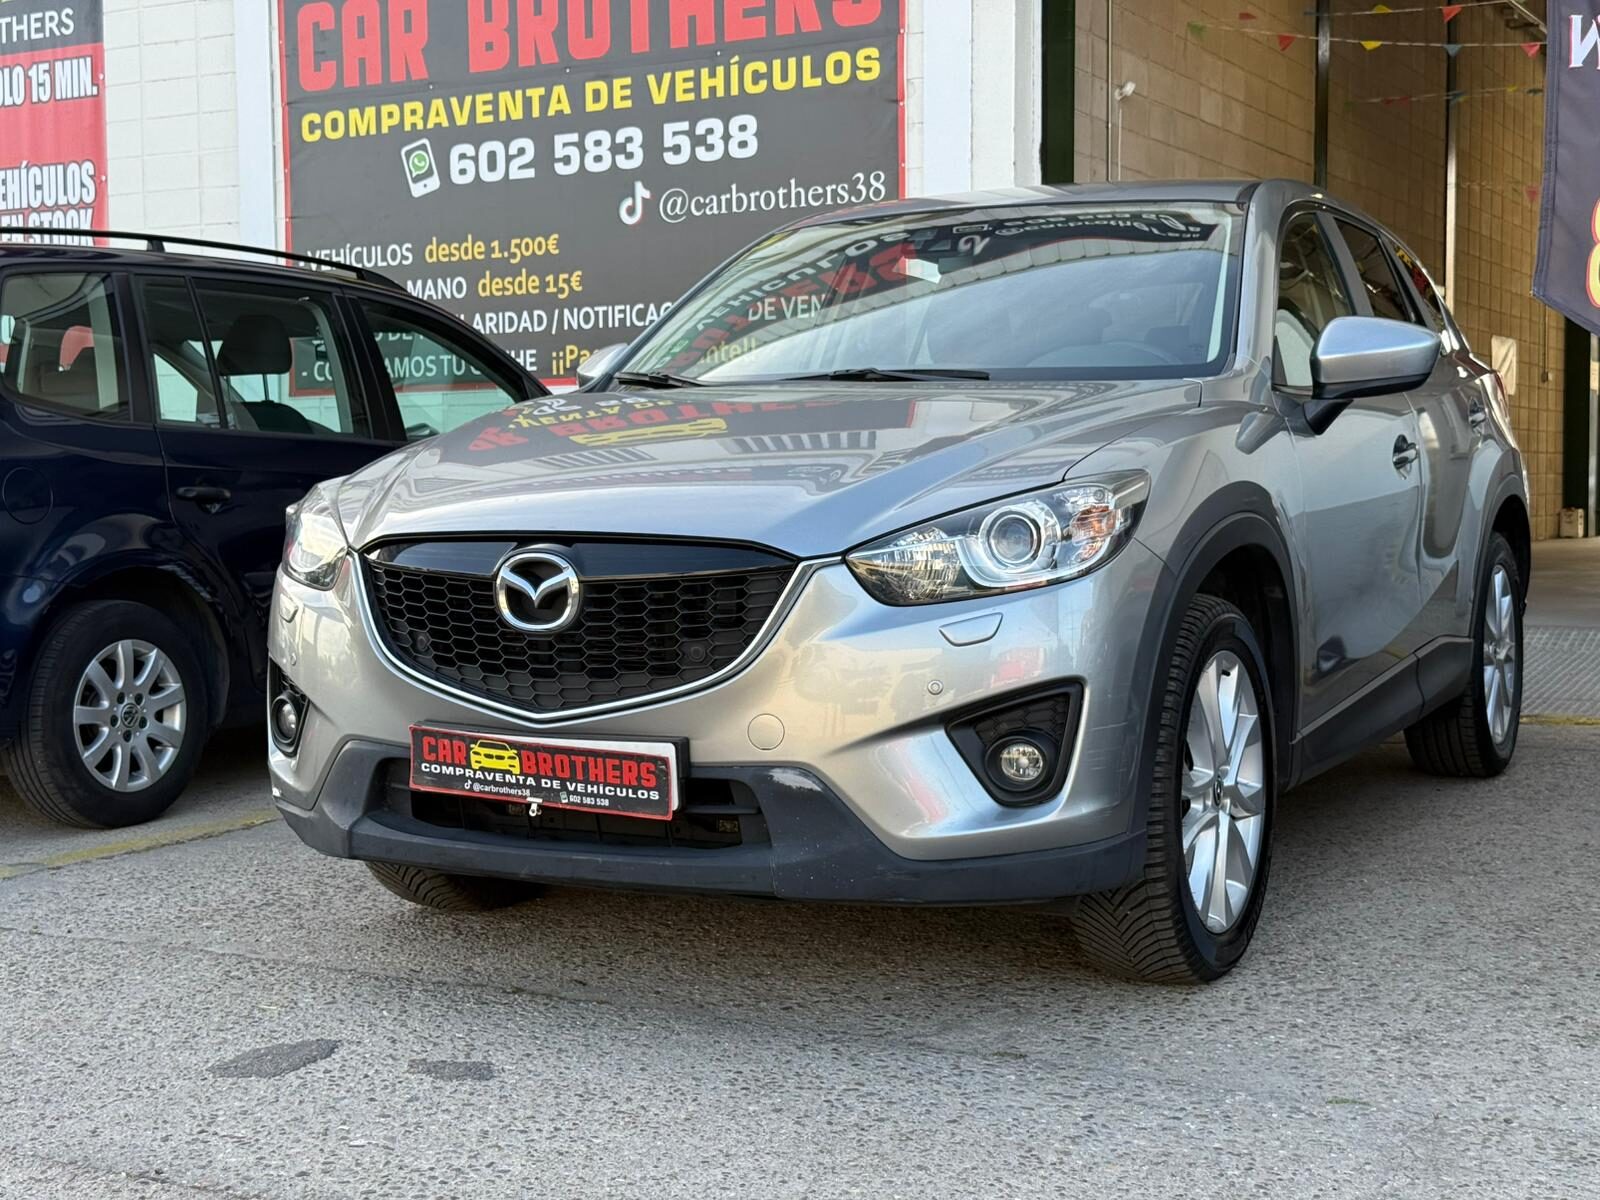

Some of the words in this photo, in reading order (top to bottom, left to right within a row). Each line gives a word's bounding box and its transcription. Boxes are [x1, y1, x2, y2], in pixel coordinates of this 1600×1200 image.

[0, 8, 75, 44] THERS
[297, 0, 429, 92] CAR
[0, 65, 26, 107] LO
[28, 61, 52, 104] 15
[54, 55, 99, 102] MIN.
[301, 84, 572, 143] COMPRAVENTA
[585, 77, 632, 112] DE
[647, 47, 881, 105] VEHÍCULOS
[449, 137, 535, 185] 602
[553, 126, 644, 175] 583
[662, 114, 759, 165] 538
[659, 170, 886, 224] @carbrothers38
[307, 243, 413, 272] VEHÍCULOS
[424, 234, 486, 263] desde
[490, 233, 560, 264] 1.500€
[406, 276, 467, 300] MANO
[477, 268, 540, 298] desde
[545, 270, 583, 299] 15€
[440, 354, 466, 377] TU
[421, 763, 537, 786] COMPRAVENTA
[541, 778, 561, 789] DE
[566, 781, 660, 800] VEHÍCULOS
[422, 736, 467, 765] CAR
[521, 750, 657, 788] BROTHERS
[569, 794, 581, 803] 602
[582, 796, 595, 805] 583
[596, 797, 609, 807] 538
